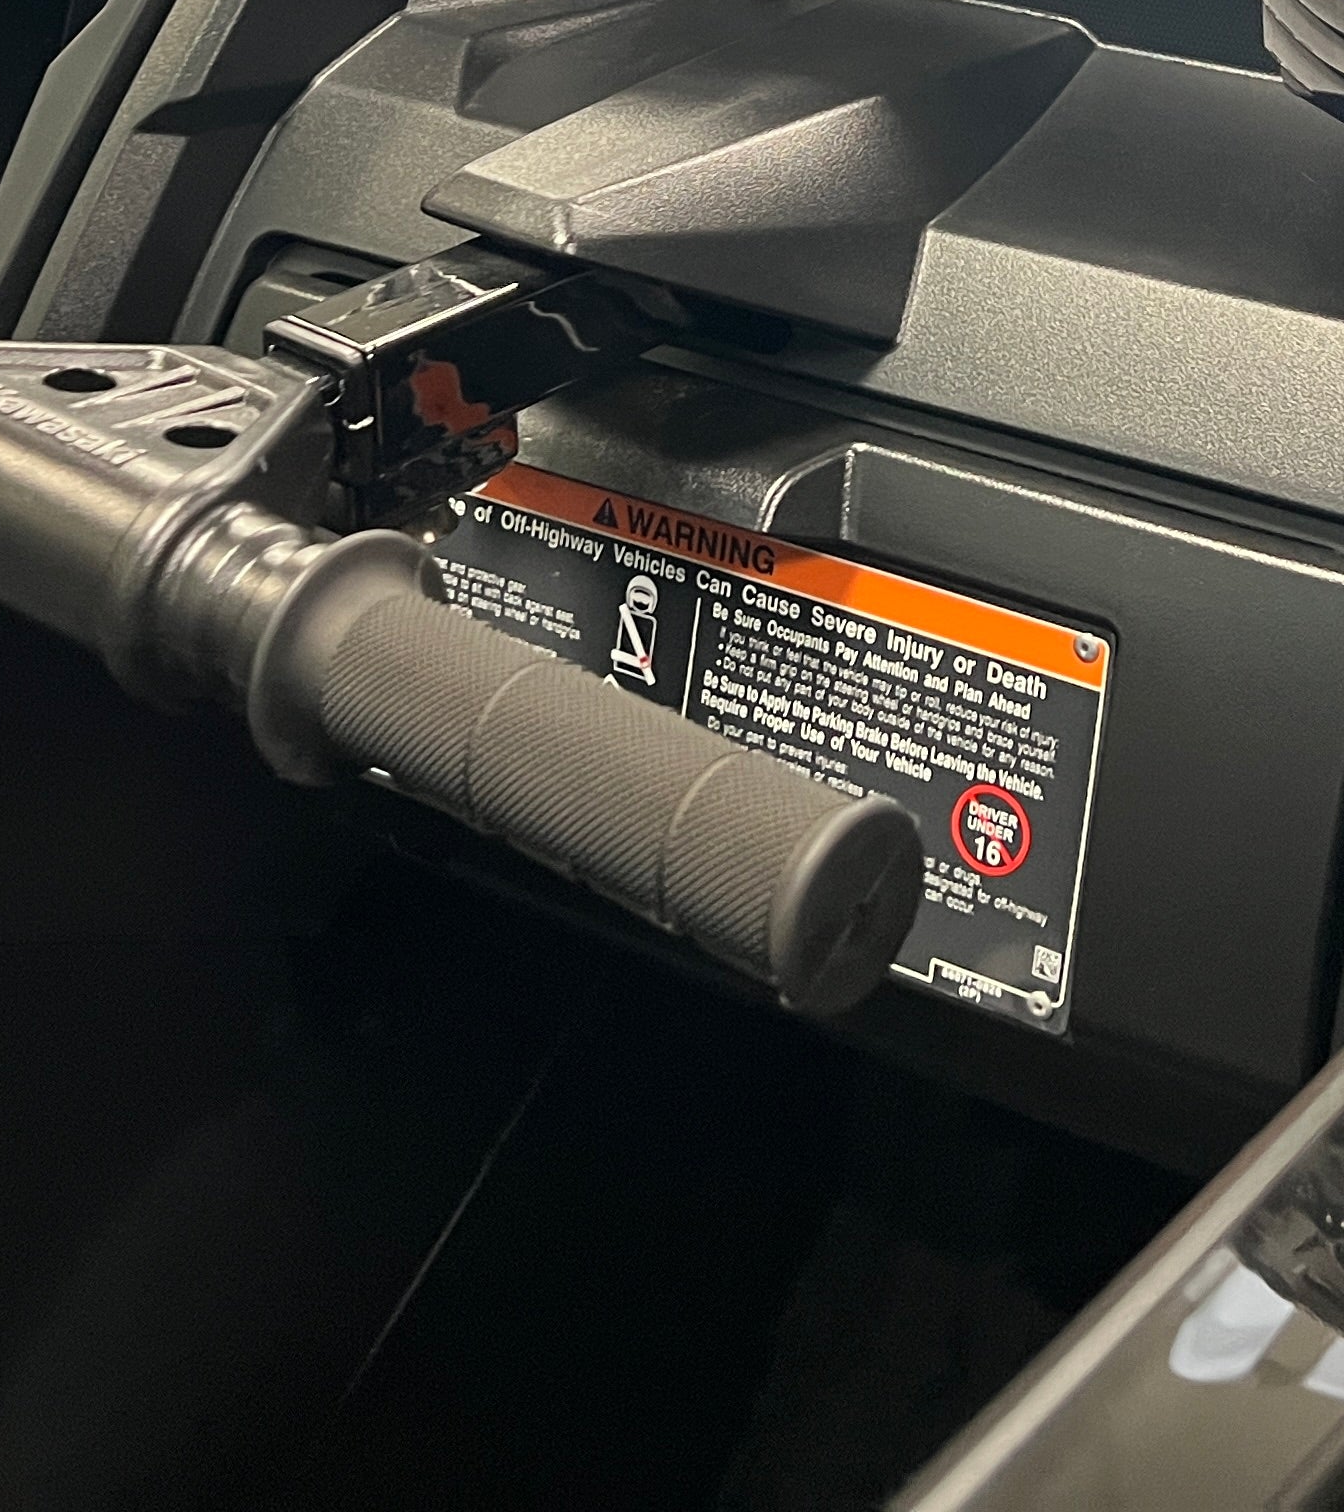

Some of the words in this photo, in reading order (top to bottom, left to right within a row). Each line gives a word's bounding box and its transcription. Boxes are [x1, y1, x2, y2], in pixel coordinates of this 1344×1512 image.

[627, 505, 775, 574] WARNING
[474, 506, 492, 523] of
[501, 511, 603, 561] Off-Highway
[614, 544, 685, 582] Vehicles
[697, 570, 731, 597] Can
[742, 585, 800, 619] Cause
[811, 606, 876, 644] Severe
[887, 629, 944, 670] Injury
[954, 656, 976, 675] or
[987, 661, 1046, 699] Death
[713, 602, 728, 620] Be
[734, 609, 761, 631] Sure
[767, 620, 829, 654] Occupants
[835, 642, 858, 666] Pay
[863, 651, 918, 683] Attention
[924, 674, 948, 693] and
[954, 680, 983, 704] Plan
[988, 692, 1030, 719] Ahead
[701, 689, 748, 718] Require
[753, 706, 795, 734] Proper
[801, 722, 825, 745] Use
[831, 736, 845, 751] of
[851, 739, 880, 763] Your
[886, 751, 931, 781] Vehicle
[704, 670, 718, 689] Be
[720, 675, 745, 698] Sure
[747, 685, 758, 702] to
[759, 689, 791, 717] Apply
[792, 700, 810, 720] the
[812, 706, 854, 738] Parking
[855, 721, 888, 747] Brake
[890, 733, 928, 760] Before
[930, 746, 975, 780] Leaving
[977, 763, 996, 783] the
[999, 769, 1043, 800] Vehicle.
[968, 816, 1013, 843] UNDER
[969, 801, 1018, 829] DRIVER
[975, 836, 1001, 865] 16
